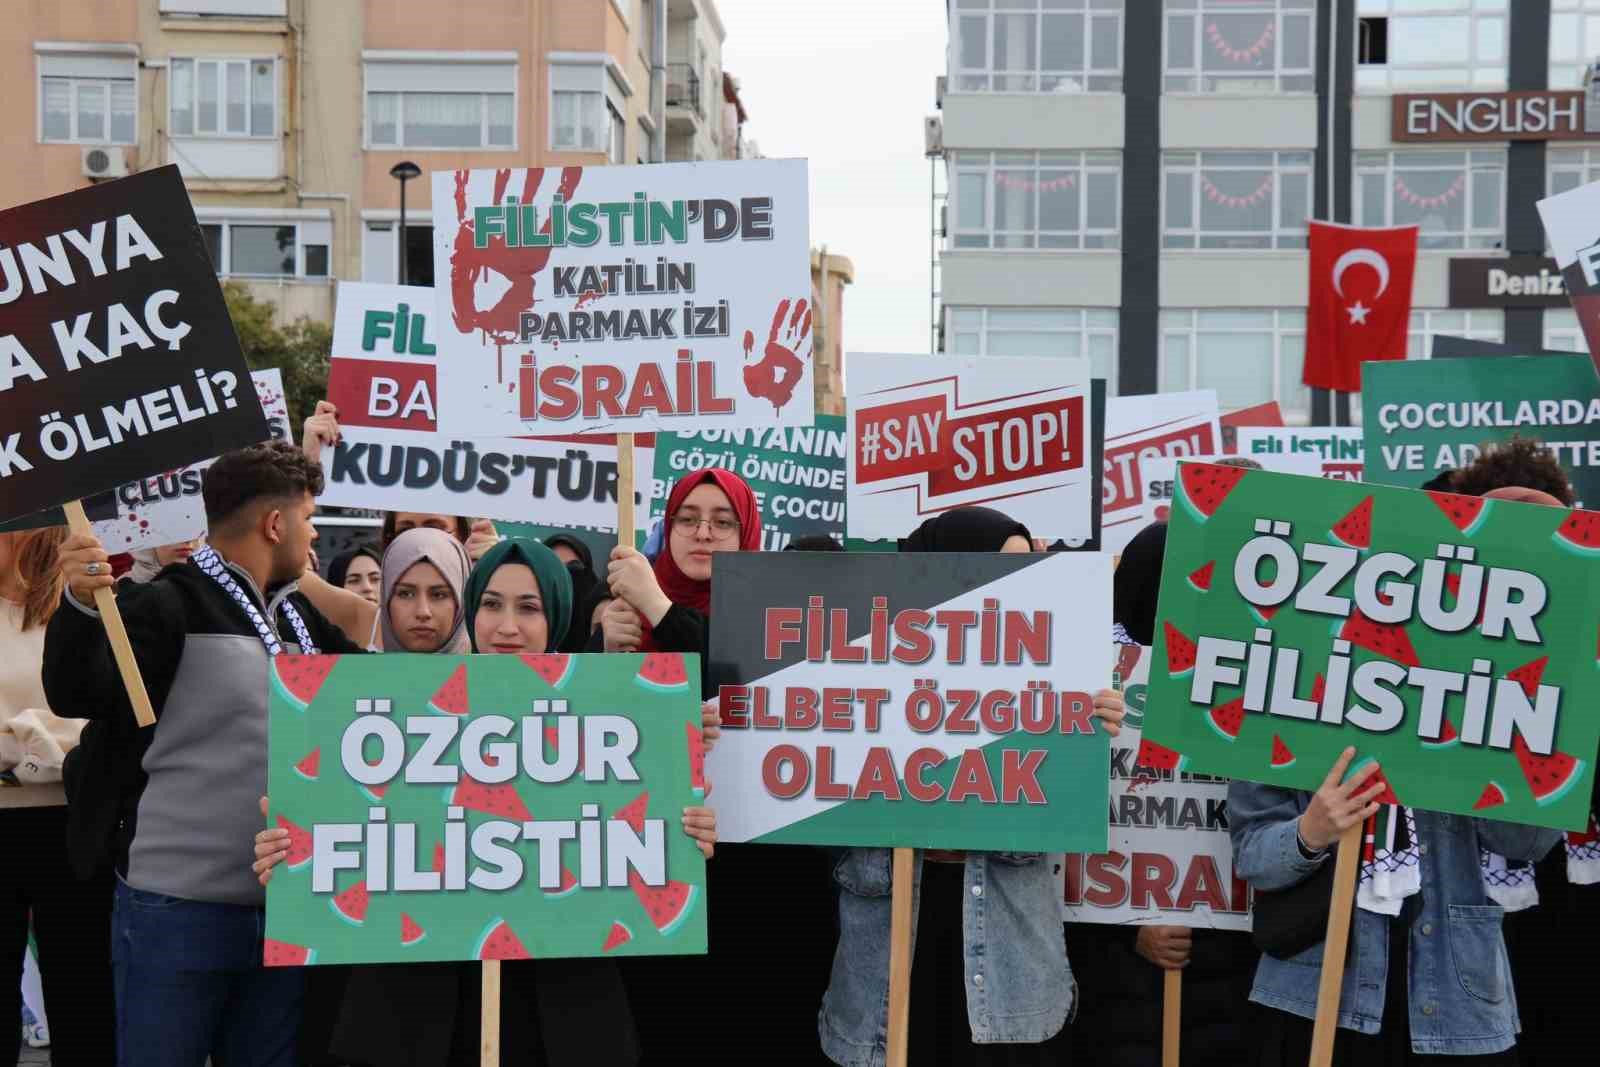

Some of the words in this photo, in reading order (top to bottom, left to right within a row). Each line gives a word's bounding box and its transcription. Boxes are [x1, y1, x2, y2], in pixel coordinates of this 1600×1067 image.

[1408, 97, 1578, 133] ENGLISH
[472, 191, 774, 249] FİLİSTİN'DE
[552, 256, 696, 299] KATİLİN
[1488, 268, 1567, 296] Deniz
[51, 289, 192, 373] KAÇ
[519, 307, 676, 344] PARMAK
[682, 300, 730, 338] İZİ
[39, 367, 239, 462] ÖLMELİ?
[518, 348, 736, 421] İSRAİL
[742, 453, 846, 491] ÖNÜNDE
[861, 411, 943, 466] #SAY
[952, 408, 1071, 482] STOP!
[1381, 443, 1425, 471] VE
[771, 495, 845, 523] ÇOCU
[1234, 518, 1548, 644] ÖZGÜR
[764, 595, 1052, 665] FİLİSTİN
[719, 684, 889, 731] ELBET
[904, 678, 1097, 736] ÖZGÜR
[1190, 627, 1561, 756] FİLİSTİN
[340, 698, 641, 785] ÖZGÜR
[761, 743, 1049, 805] OLACAK
[311, 803, 667, 894] FİLİSTİN
